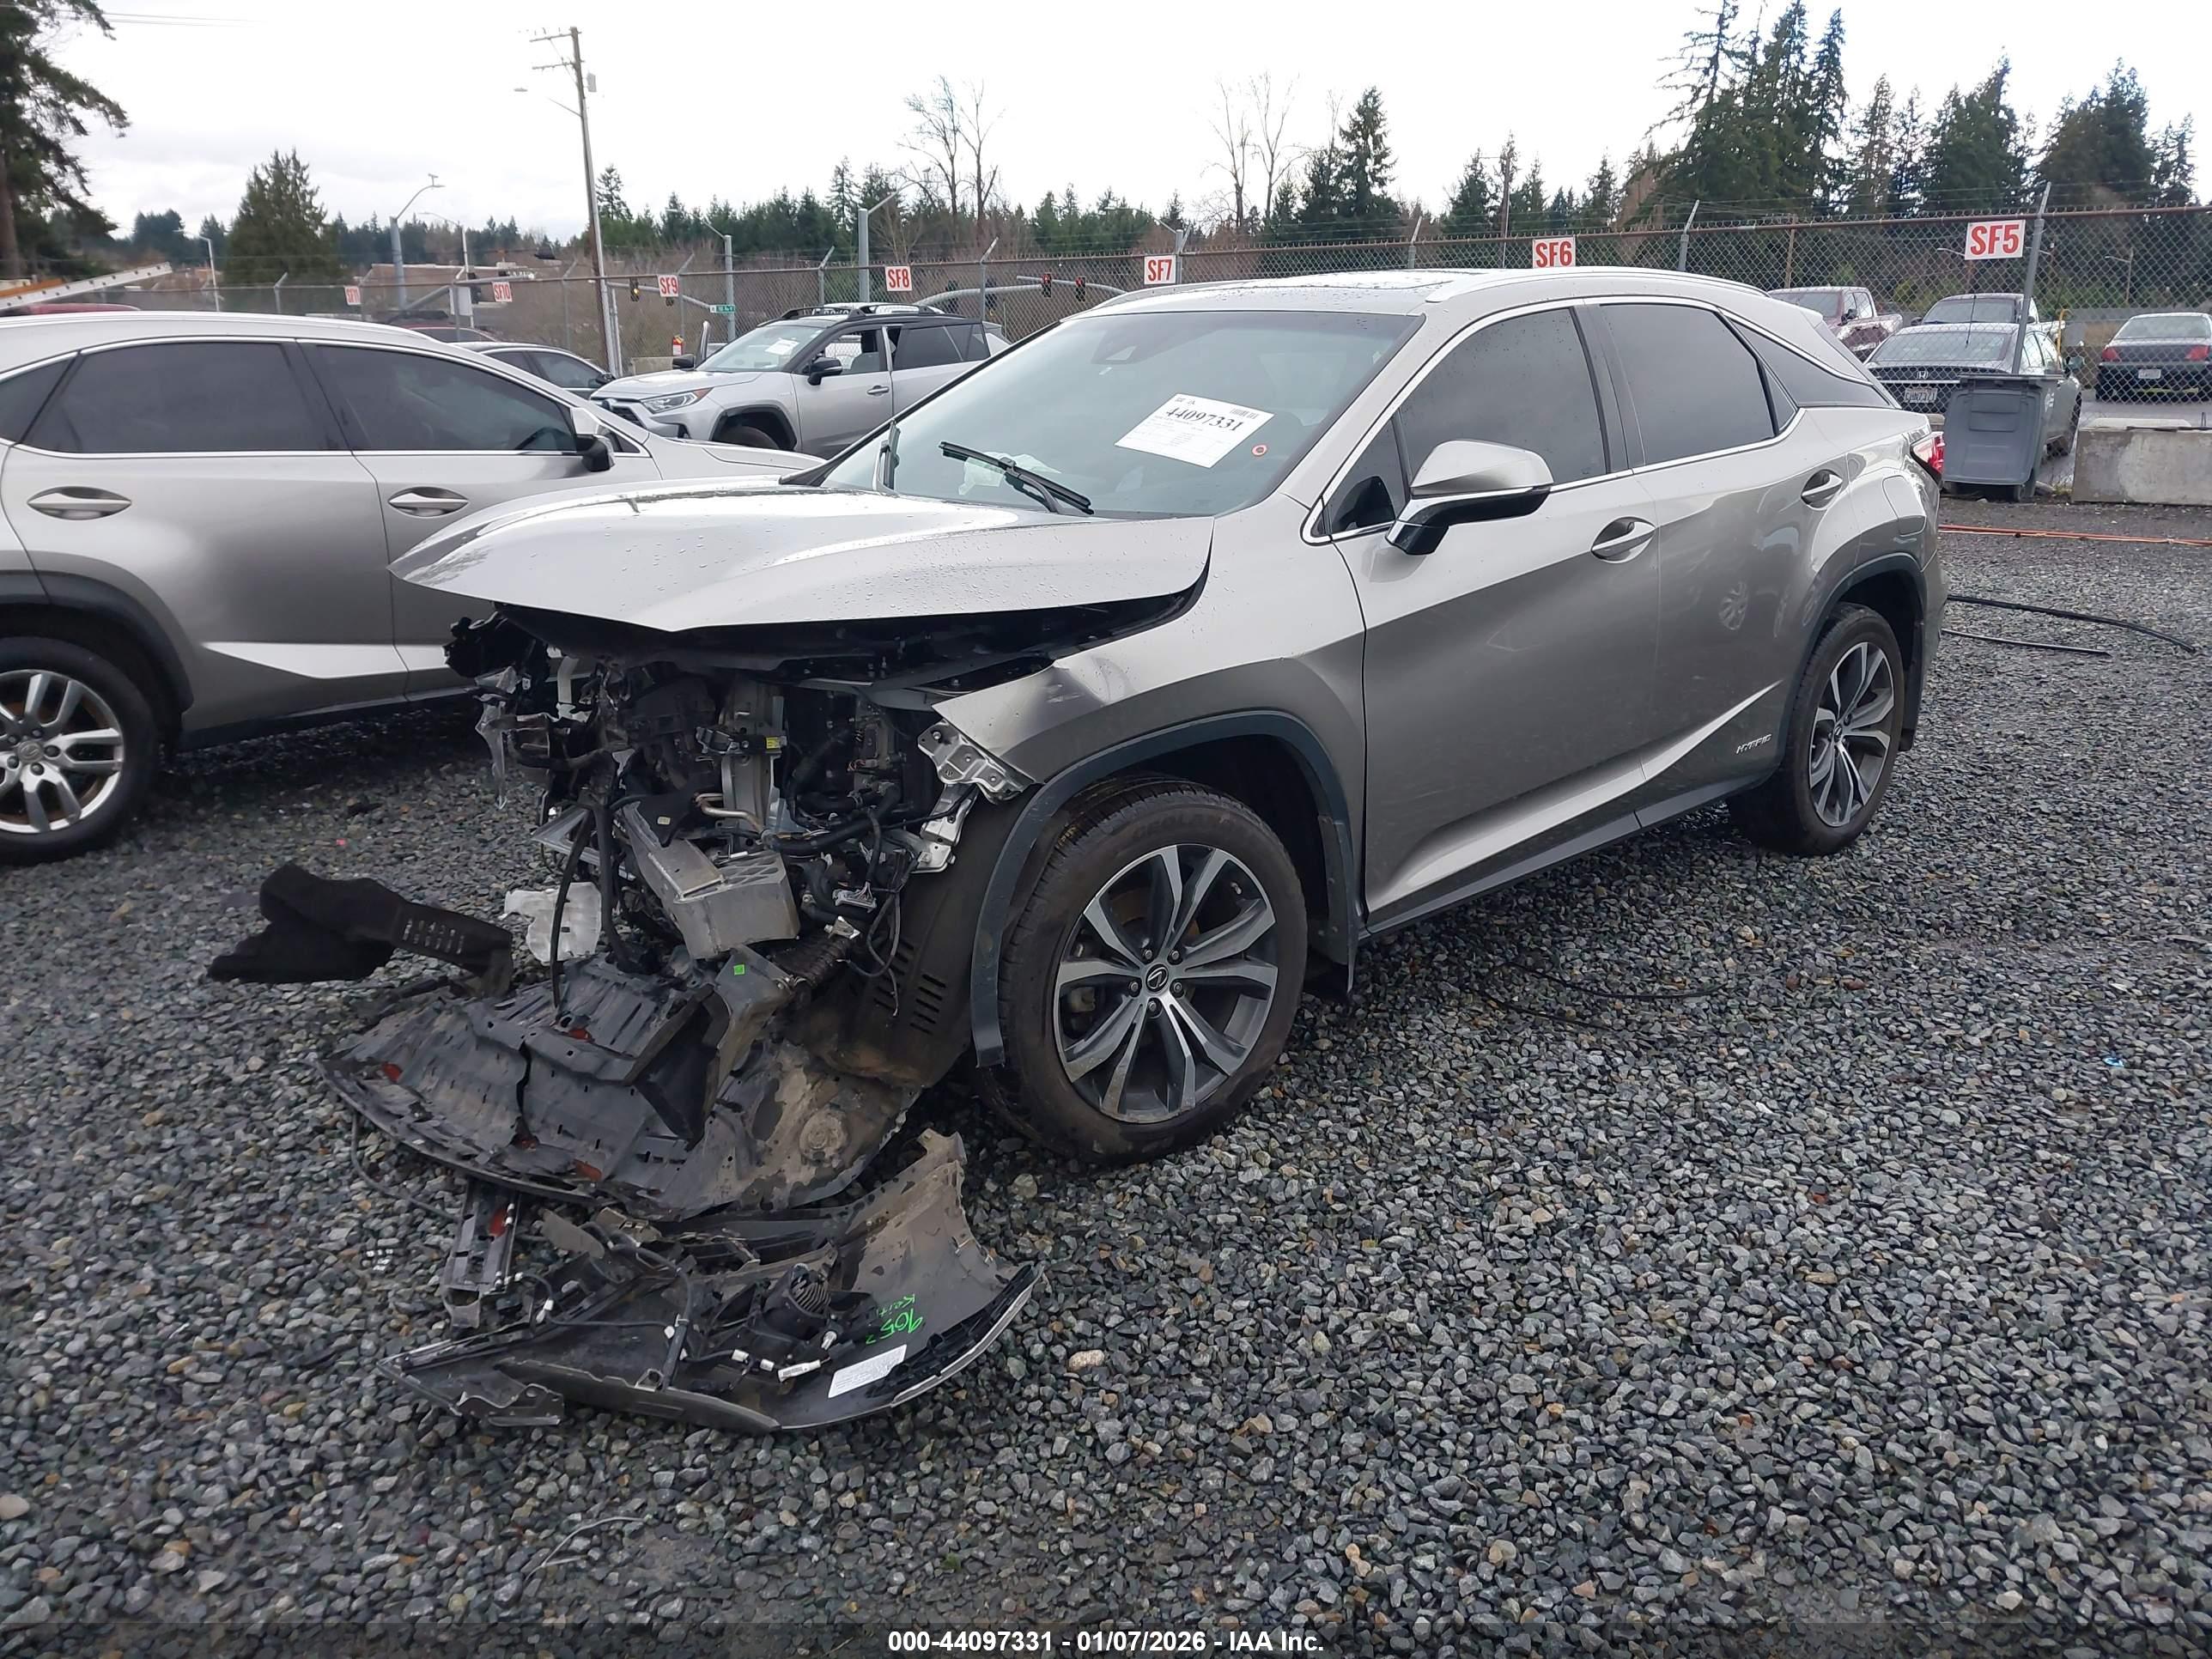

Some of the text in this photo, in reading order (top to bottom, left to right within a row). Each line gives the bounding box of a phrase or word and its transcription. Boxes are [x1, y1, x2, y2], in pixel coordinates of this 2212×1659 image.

[1971, 224, 2020, 255] SF5
[1535, 241, 1573, 268] SF6
[888, 268, 910, 289] SF8
[1147, 258, 1173, 282] SF7
[494, 283, 511, 300] SF10
[659, 276, 678, 295] SF9
[1166, 407, 1244, 431] 44097331
